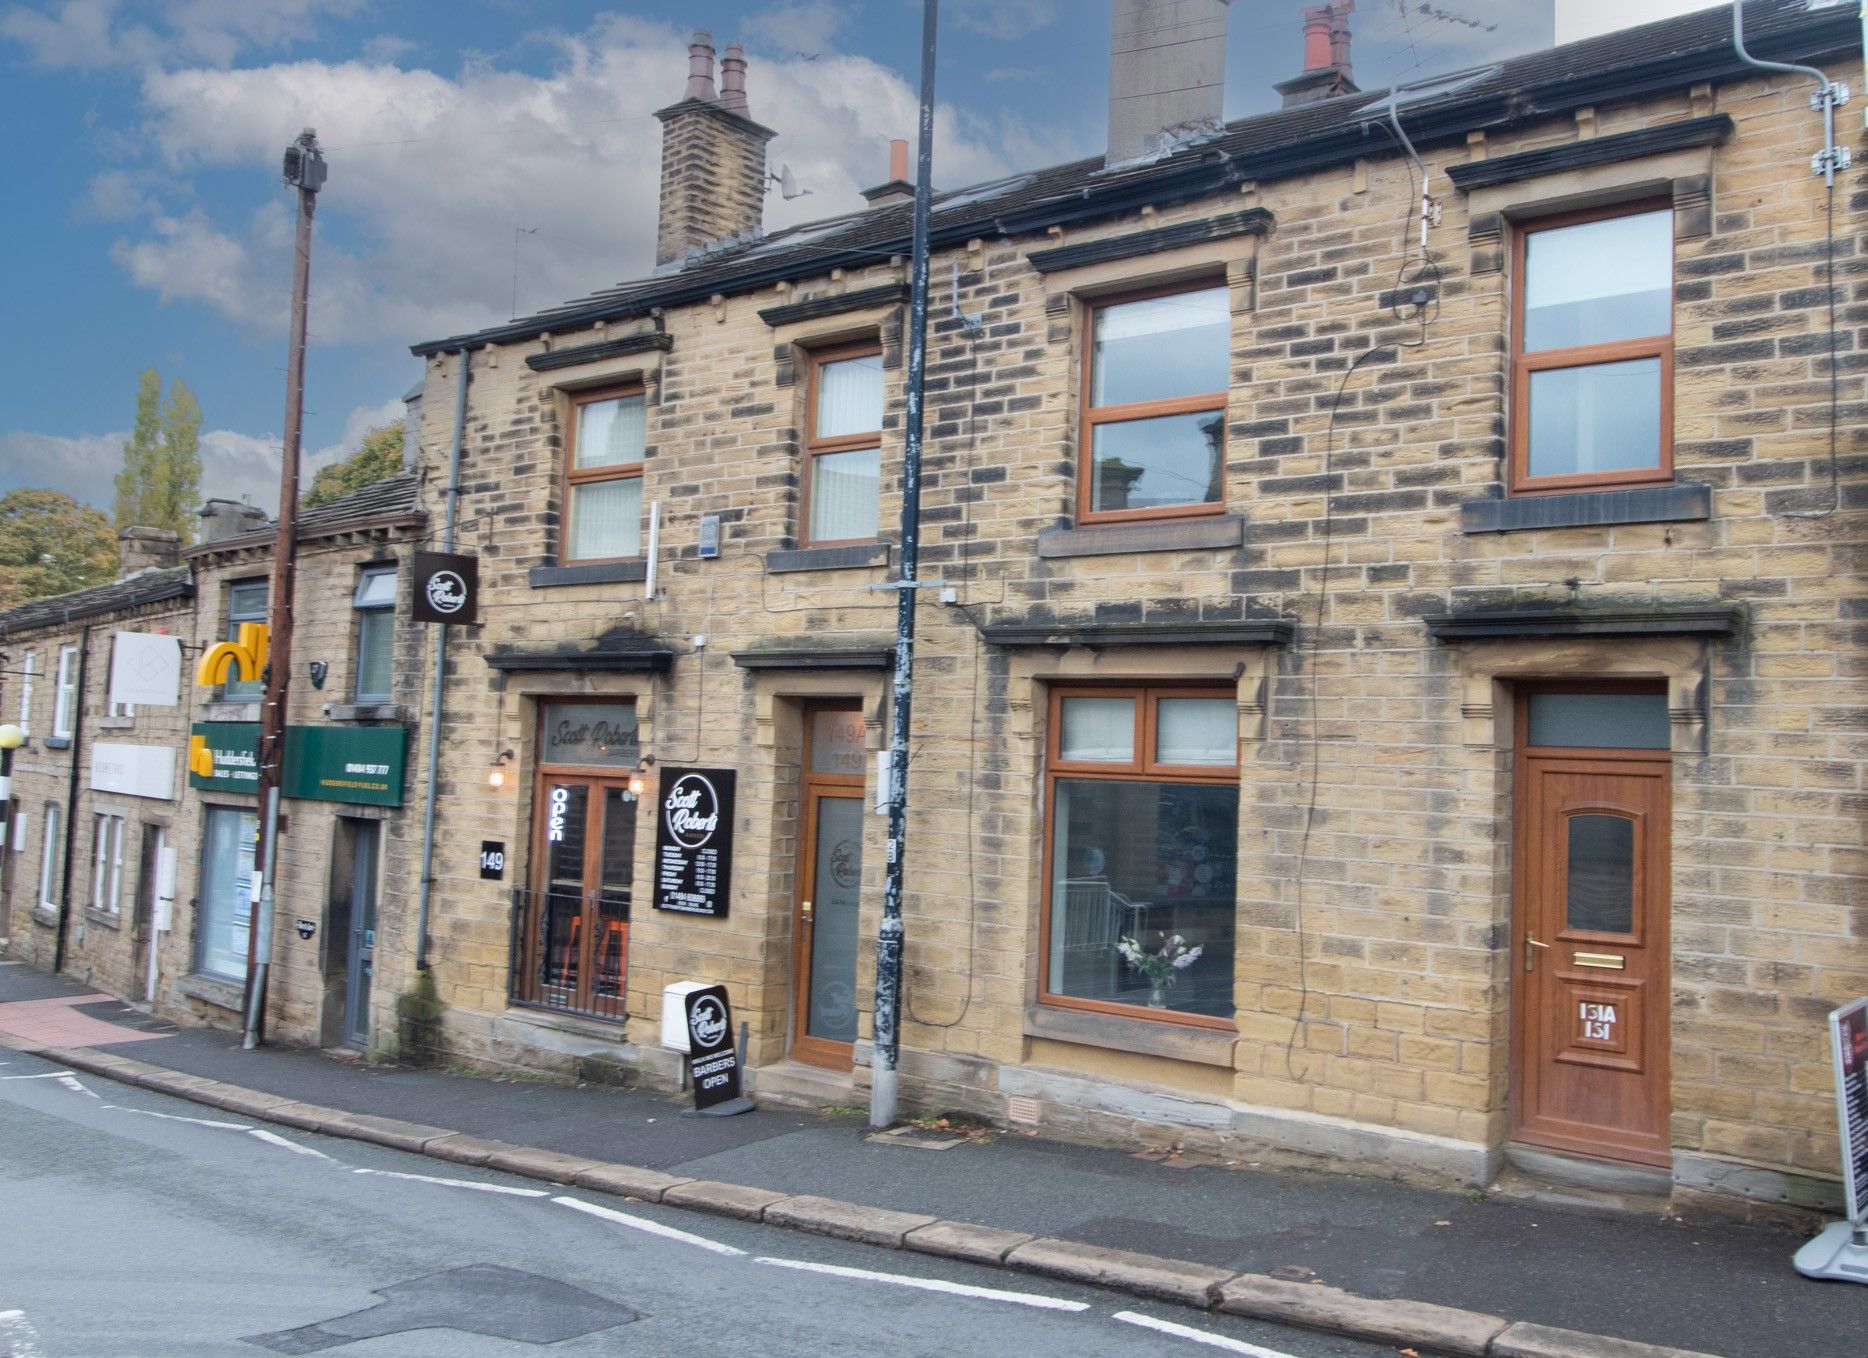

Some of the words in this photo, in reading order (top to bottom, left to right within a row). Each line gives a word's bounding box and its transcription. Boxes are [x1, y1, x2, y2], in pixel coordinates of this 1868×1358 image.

[426, 577, 454, 591] Scott
[552, 720, 590, 746] Scott
[591, 721, 639, 751] Robert
[665, 787, 702, 810] Scott
[549, 788, 568, 842] open
[672, 808, 718, 834] Roberts
[480, 851, 504, 870] 149
[693, 1056, 736, 1078] BARBERS
[702, 1073, 729, 1089] OPEN
